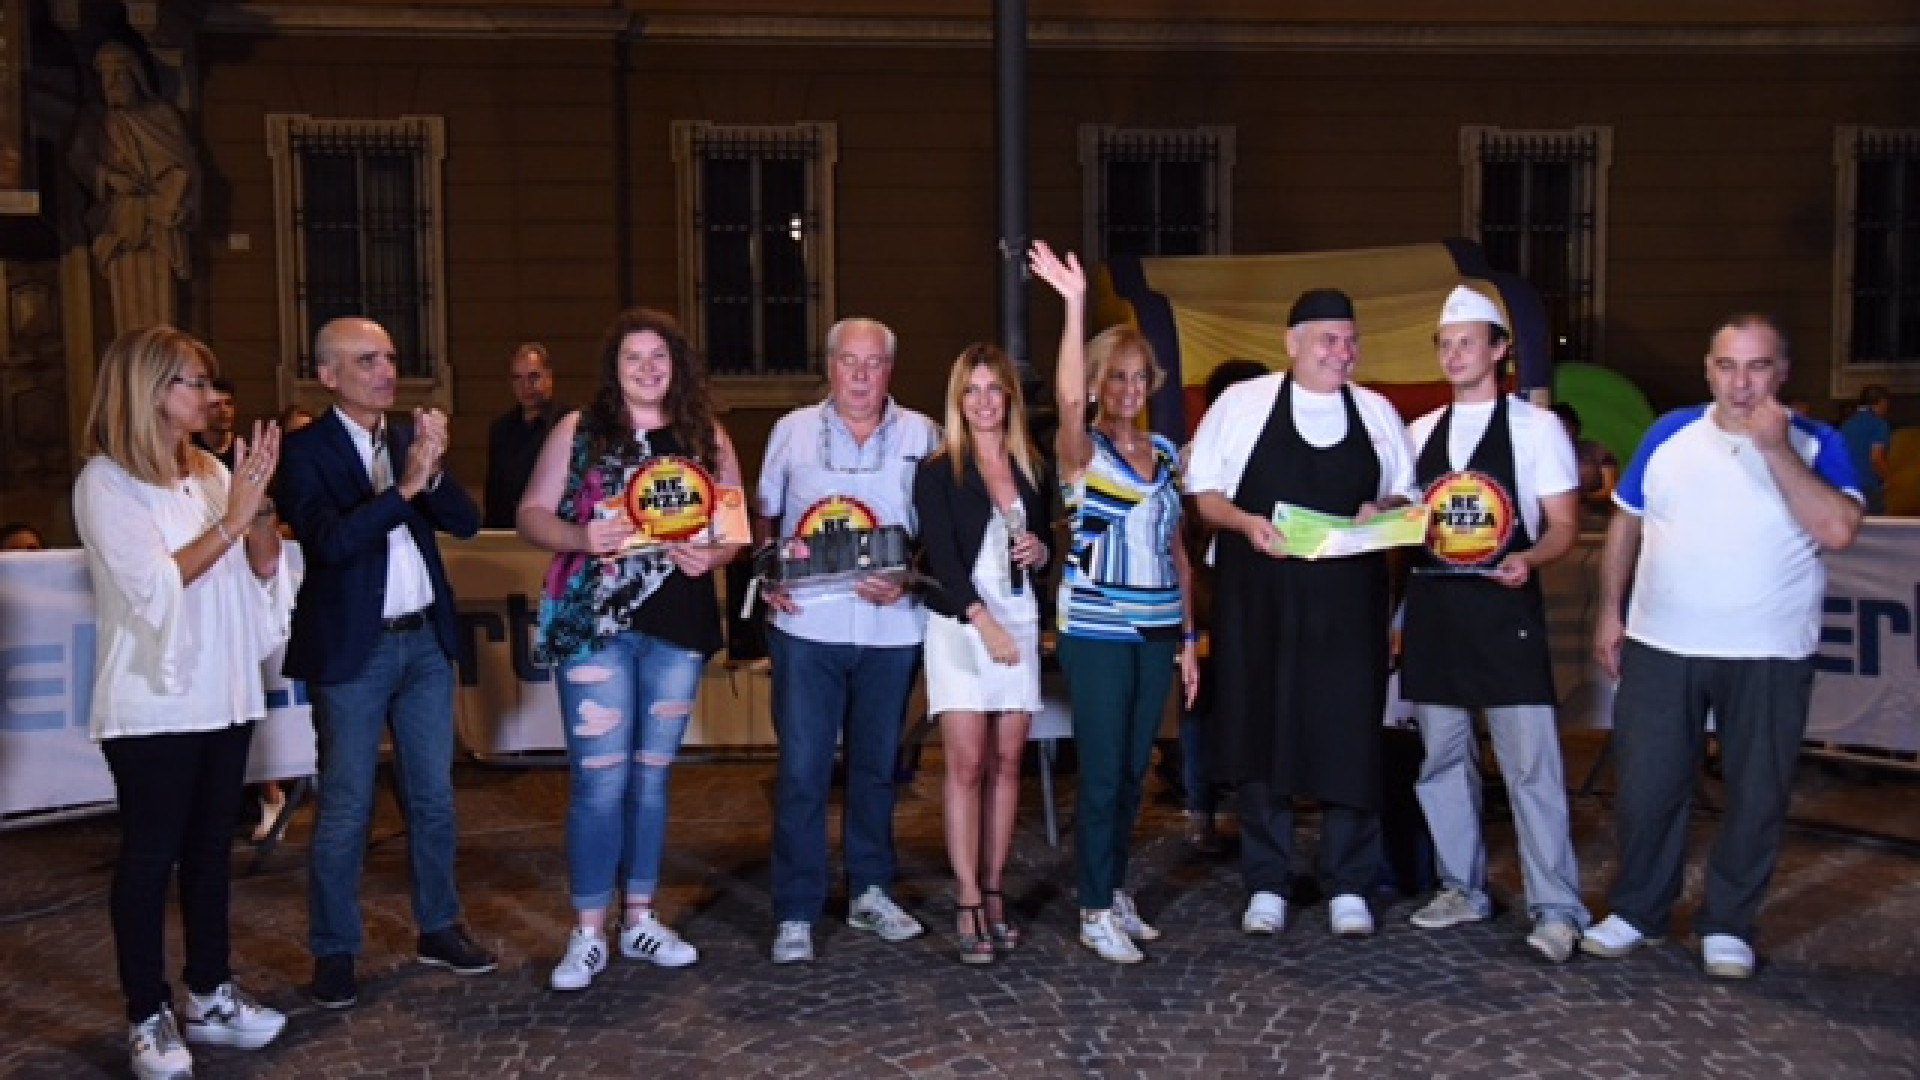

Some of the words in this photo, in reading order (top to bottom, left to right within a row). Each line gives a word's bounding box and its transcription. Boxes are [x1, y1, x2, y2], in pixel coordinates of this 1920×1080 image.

[638, 490, 703, 511] PIZZA
[1451, 495, 1481, 512] RE
[1432, 511, 1496, 528] PIZZA
